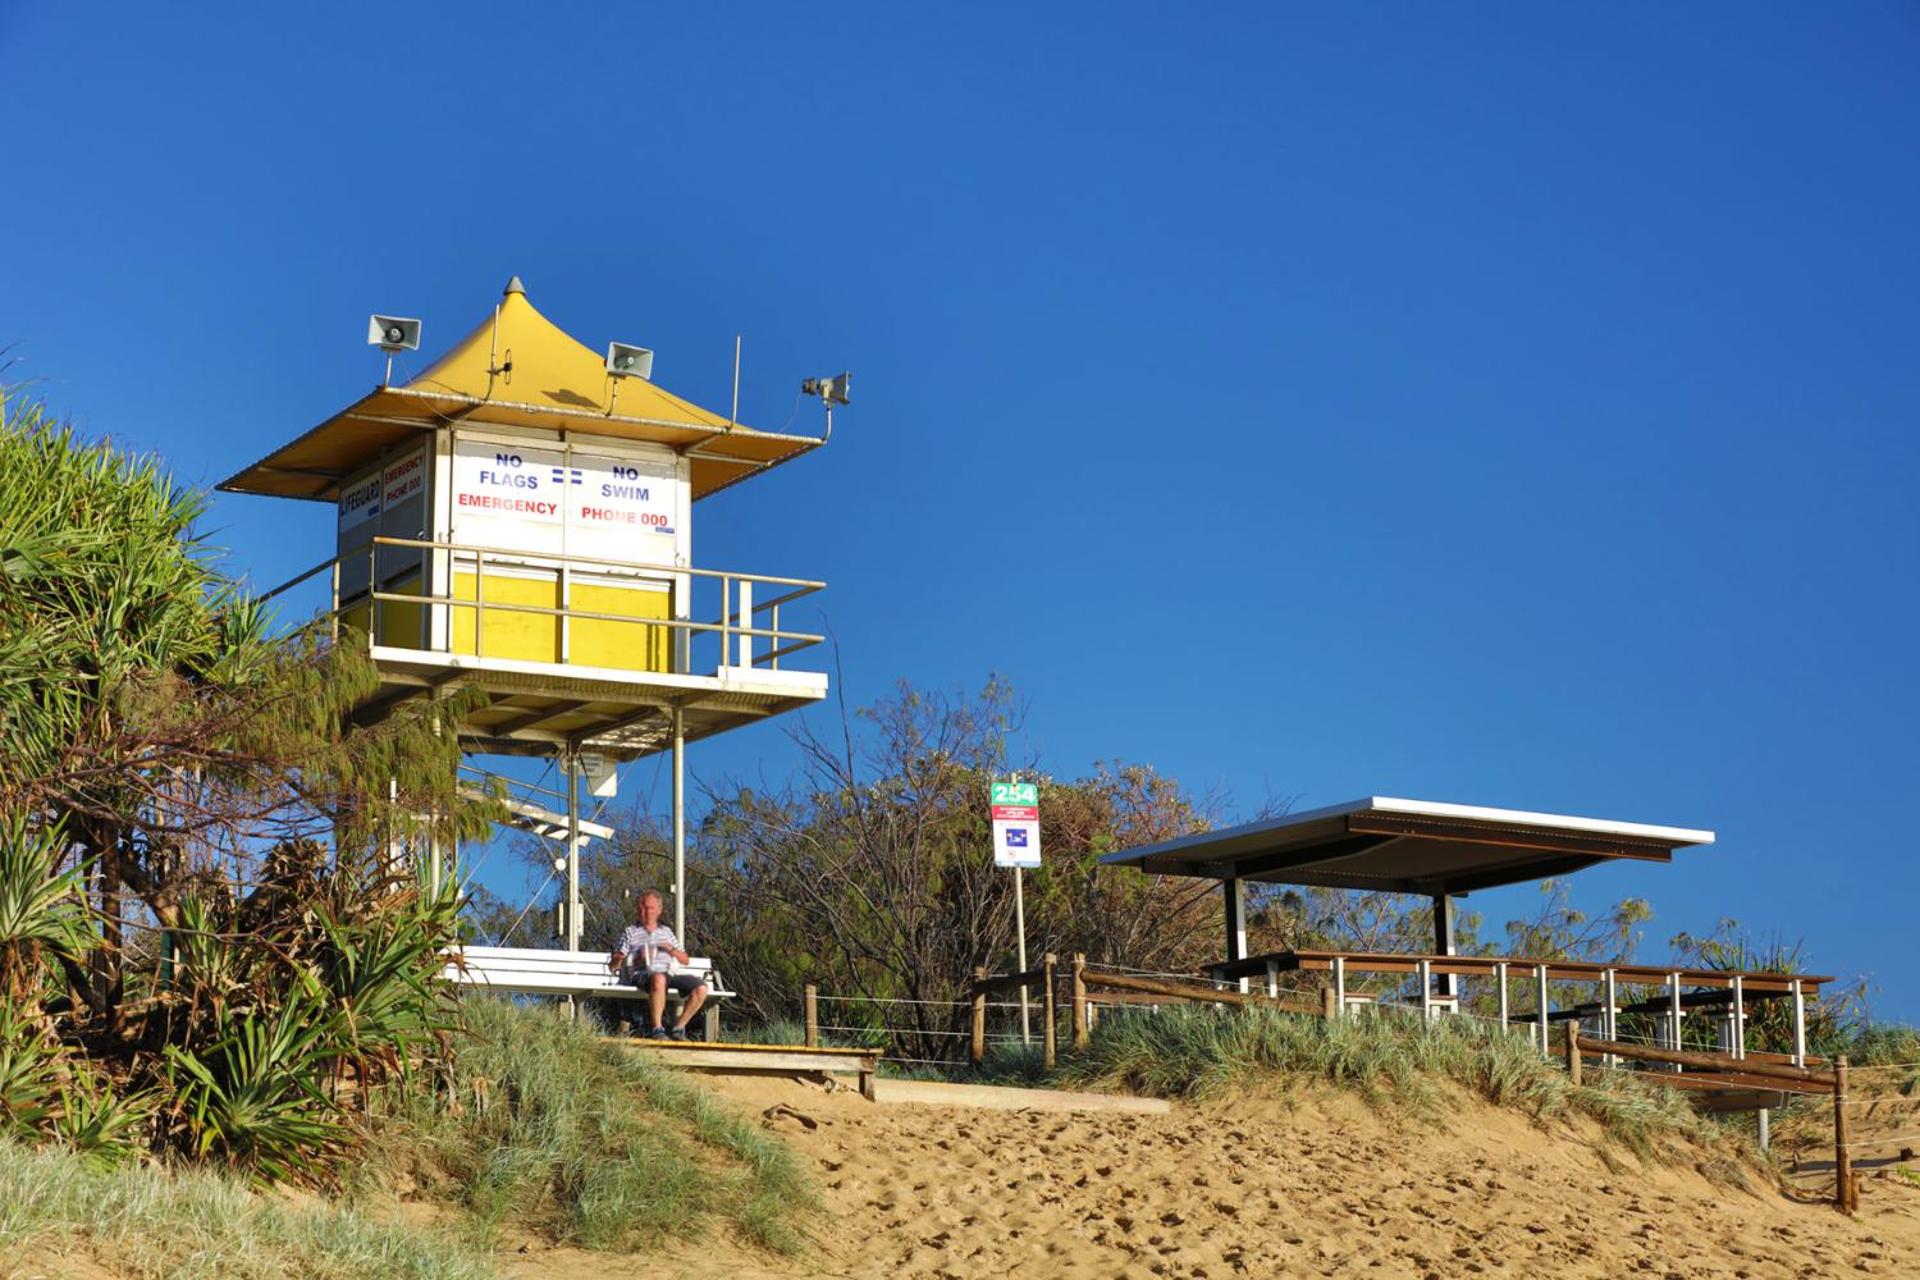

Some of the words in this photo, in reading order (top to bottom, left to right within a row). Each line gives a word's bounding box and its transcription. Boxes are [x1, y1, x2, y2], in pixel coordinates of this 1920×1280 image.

[496, 453, 522, 468] NO
[385, 456, 423, 484] EMERGENCY
[613, 466, 638, 481] NO
[480, 471, 538, 489] FLAGS
[341, 479, 381, 515] LIFEGUARD
[601, 484, 649, 501] SWIM
[458, 494, 557, 515] EMERGENCY
[582, 507, 636, 524] PHONE
[641, 513, 667, 527] 000
[995, 785, 1034, 803] 254
